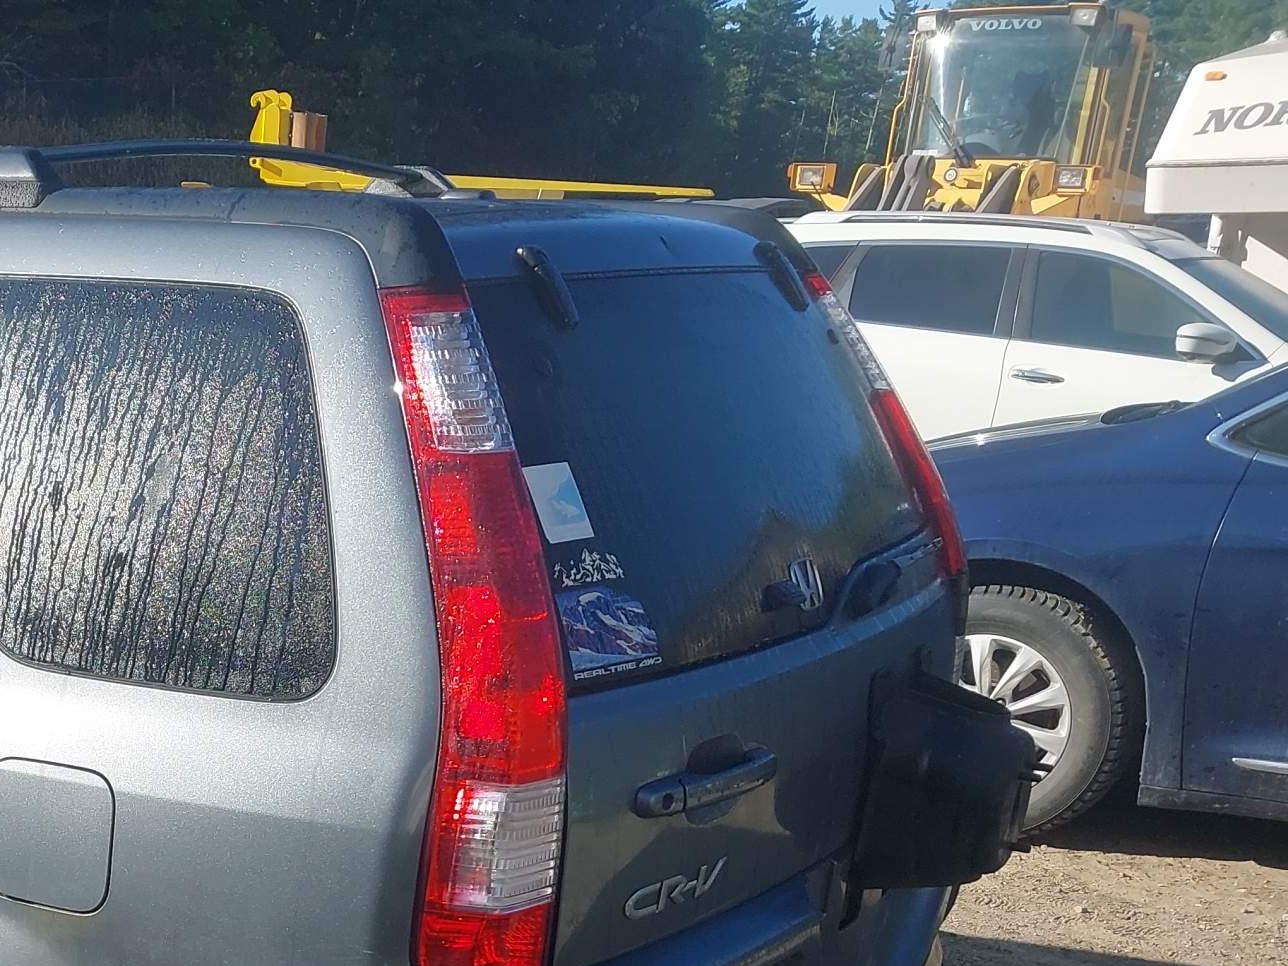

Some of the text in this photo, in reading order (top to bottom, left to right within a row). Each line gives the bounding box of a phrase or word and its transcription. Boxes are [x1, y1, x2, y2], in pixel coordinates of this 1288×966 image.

[970, 19, 1042, 31] VOLVO
[574, 656, 663, 681] REALTIME AWD
[623, 856, 728, 919] CR-V
